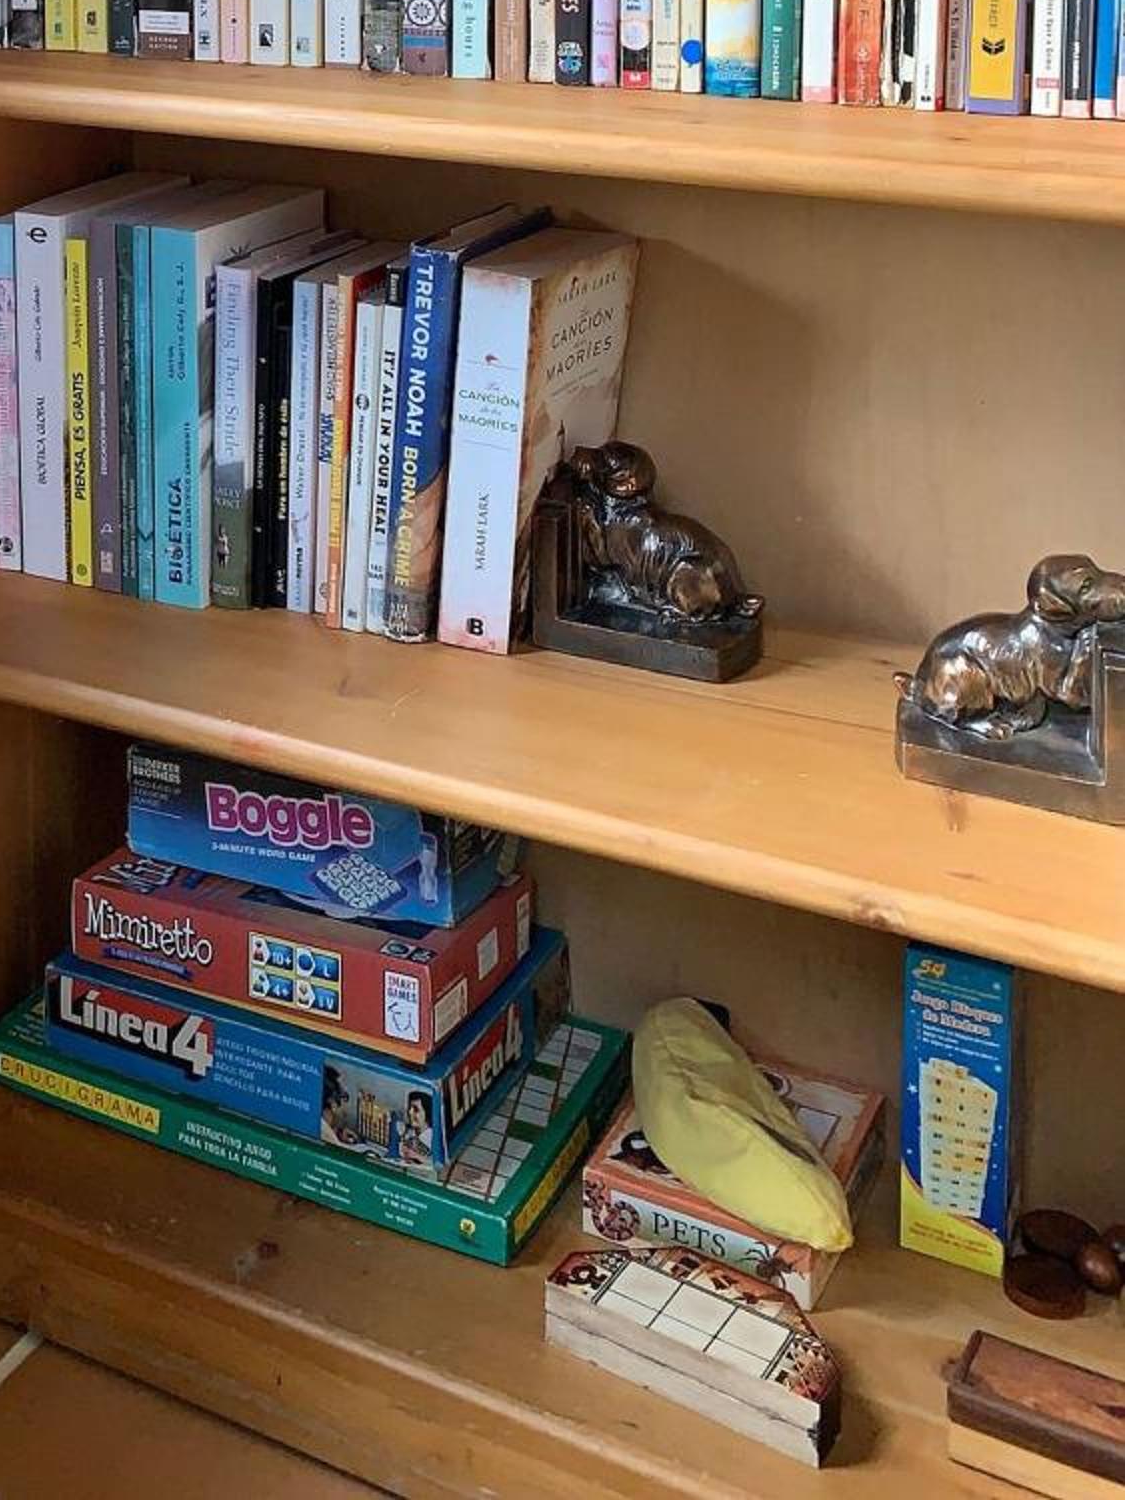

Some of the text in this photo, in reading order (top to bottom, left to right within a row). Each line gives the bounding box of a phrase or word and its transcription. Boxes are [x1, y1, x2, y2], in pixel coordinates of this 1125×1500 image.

[464, 16, 476, 58] hours
[223, 282, 241, 458] Finding Their Stride
[376, 350, 396, 489] IT'S ALL IN YOUR
[394, 265, 433, 587] TREVOR NOAH BORN A CRIME
[459, 390, 520, 409] CANCIÓN
[459, 414, 518, 433] MAORÍES
[72, 372, 86, 500] PIENSA, ES GRATIS
[278, 425, 288, 519] Para un hombre de
[295, 547, 304, 578] norma
[205, 782, 374, 850] Boggle
[258, 849, 286, 859] WORD
[289, 852, 316, 863] GAME
[85, 893, 213, 965] Mimiretto
[387, 974, 418, 991] SMART
[387, 986, 419, 1002] GAMES
[60, 974, 213, 1077] Línea 4
[0, 1056, 156, 1128] CRUCIGRAMA
[450, 1008, 522, 1126] Línea 4
[178, 1133, 240, 1162] PARA LA
[186, 1121, 273, 1159] INSTRUCTIVO JUEGO
[652, 1210, 728, 1258] PETS
